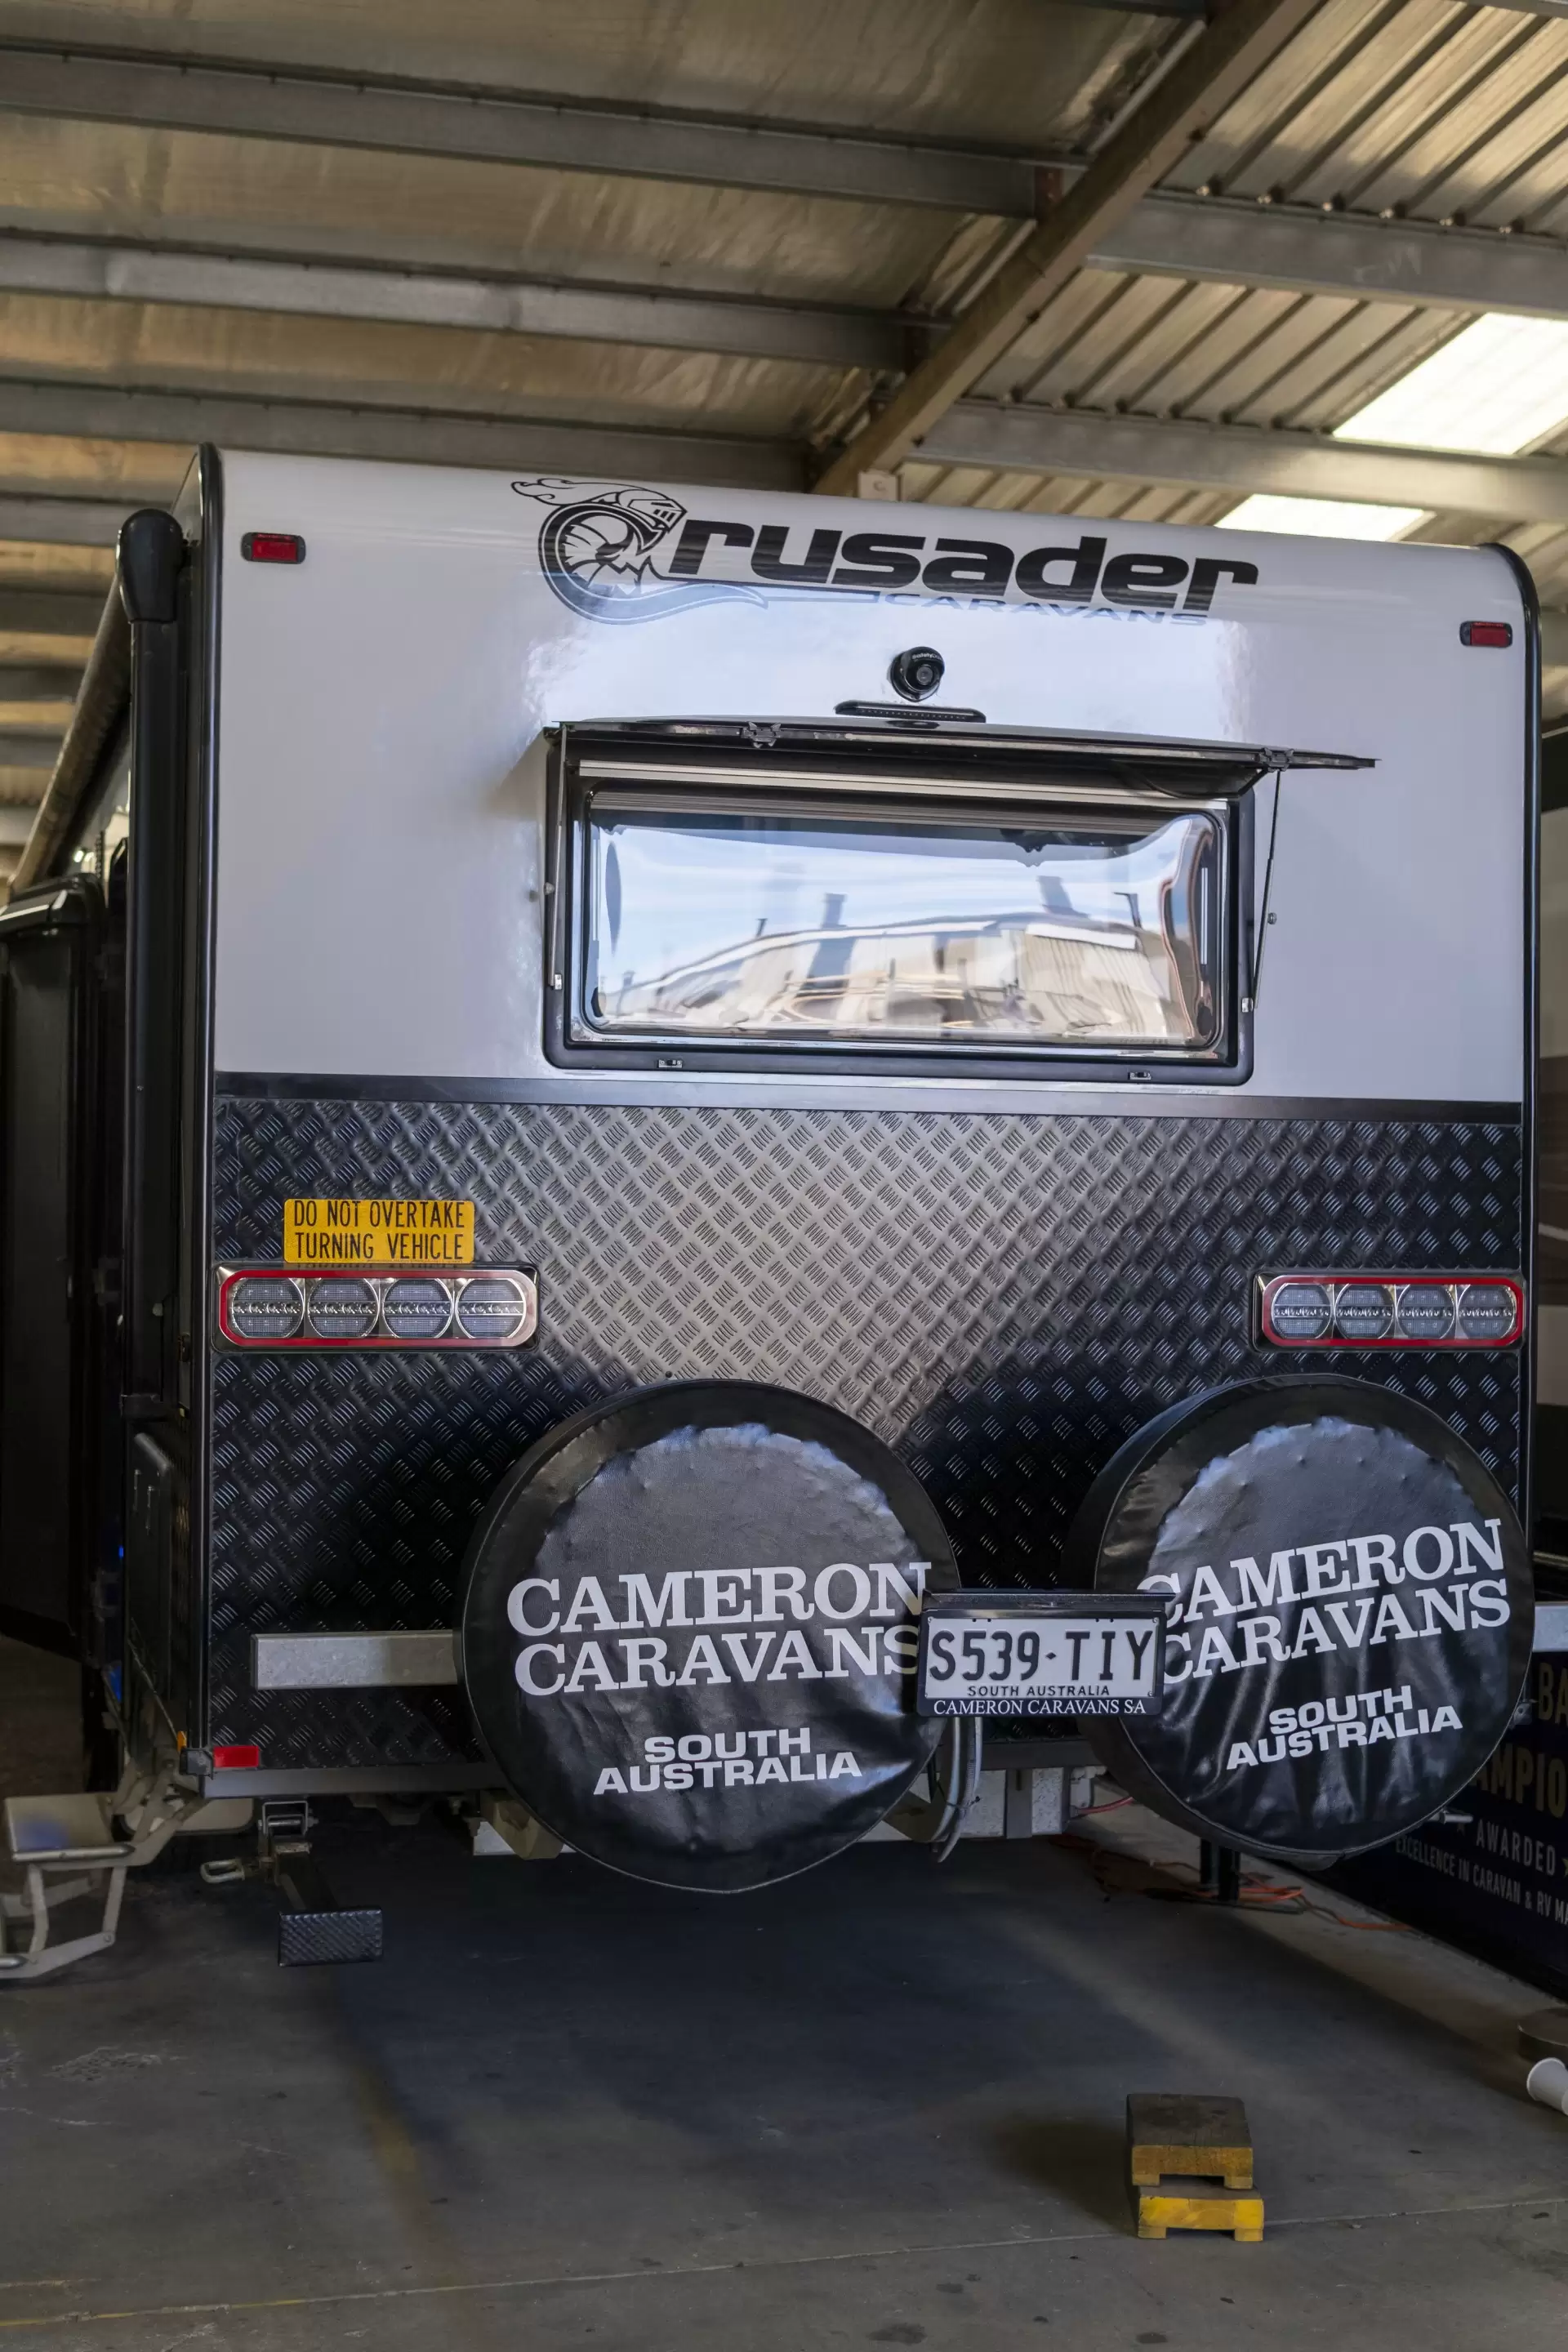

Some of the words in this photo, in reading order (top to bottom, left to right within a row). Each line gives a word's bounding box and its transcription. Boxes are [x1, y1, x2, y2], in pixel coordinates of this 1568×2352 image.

[884, 592, 1207, 626] CARAVANS
[294, 1200, 318, 1227] DO
[327, 1200, 360, 1227] NOT
[370, 1200, 465, 1229] OVERTAKE
[295, 1232, 373, 1259] TURNING
[387, 1233, 464, 1260] VEHICLE
[506, 1561, 931, 1637] CAMERON
[1164, 1578, 1511, 1685] CARAVANS
[514, 1624, 921, 1695] CARAVANS
[933, 1699, 1023, 1715] CAMERON
[1027, 1699, 1120, 1714] CARAVANS
[1124, 1698, 1147, 1714] SA
[968, 1686, 1019, 1697] SOUTH
[1027, 1685, 1110, 1696] AUSTRALIA
[1269, 1685, 1413, 1735] SOUTH
[644, 1727, 810, 1763] SOUTH
[1227, 1705, 1463, 1771] AUSTRALIA
[593, 1752, 862, 1795] AUSTRALIA
[1476, 1818, 1557, 1877] AWARDED
[1396, 1833, 1456, 1877] EXCELLENCE
[1458, 1858, 1470, 1882] IN
[1472, 1863, 1521, 1905] CARAVAN
[1525, 1891, 1533, 1910] &
[1536, 1890, 1552, 1918] RV
